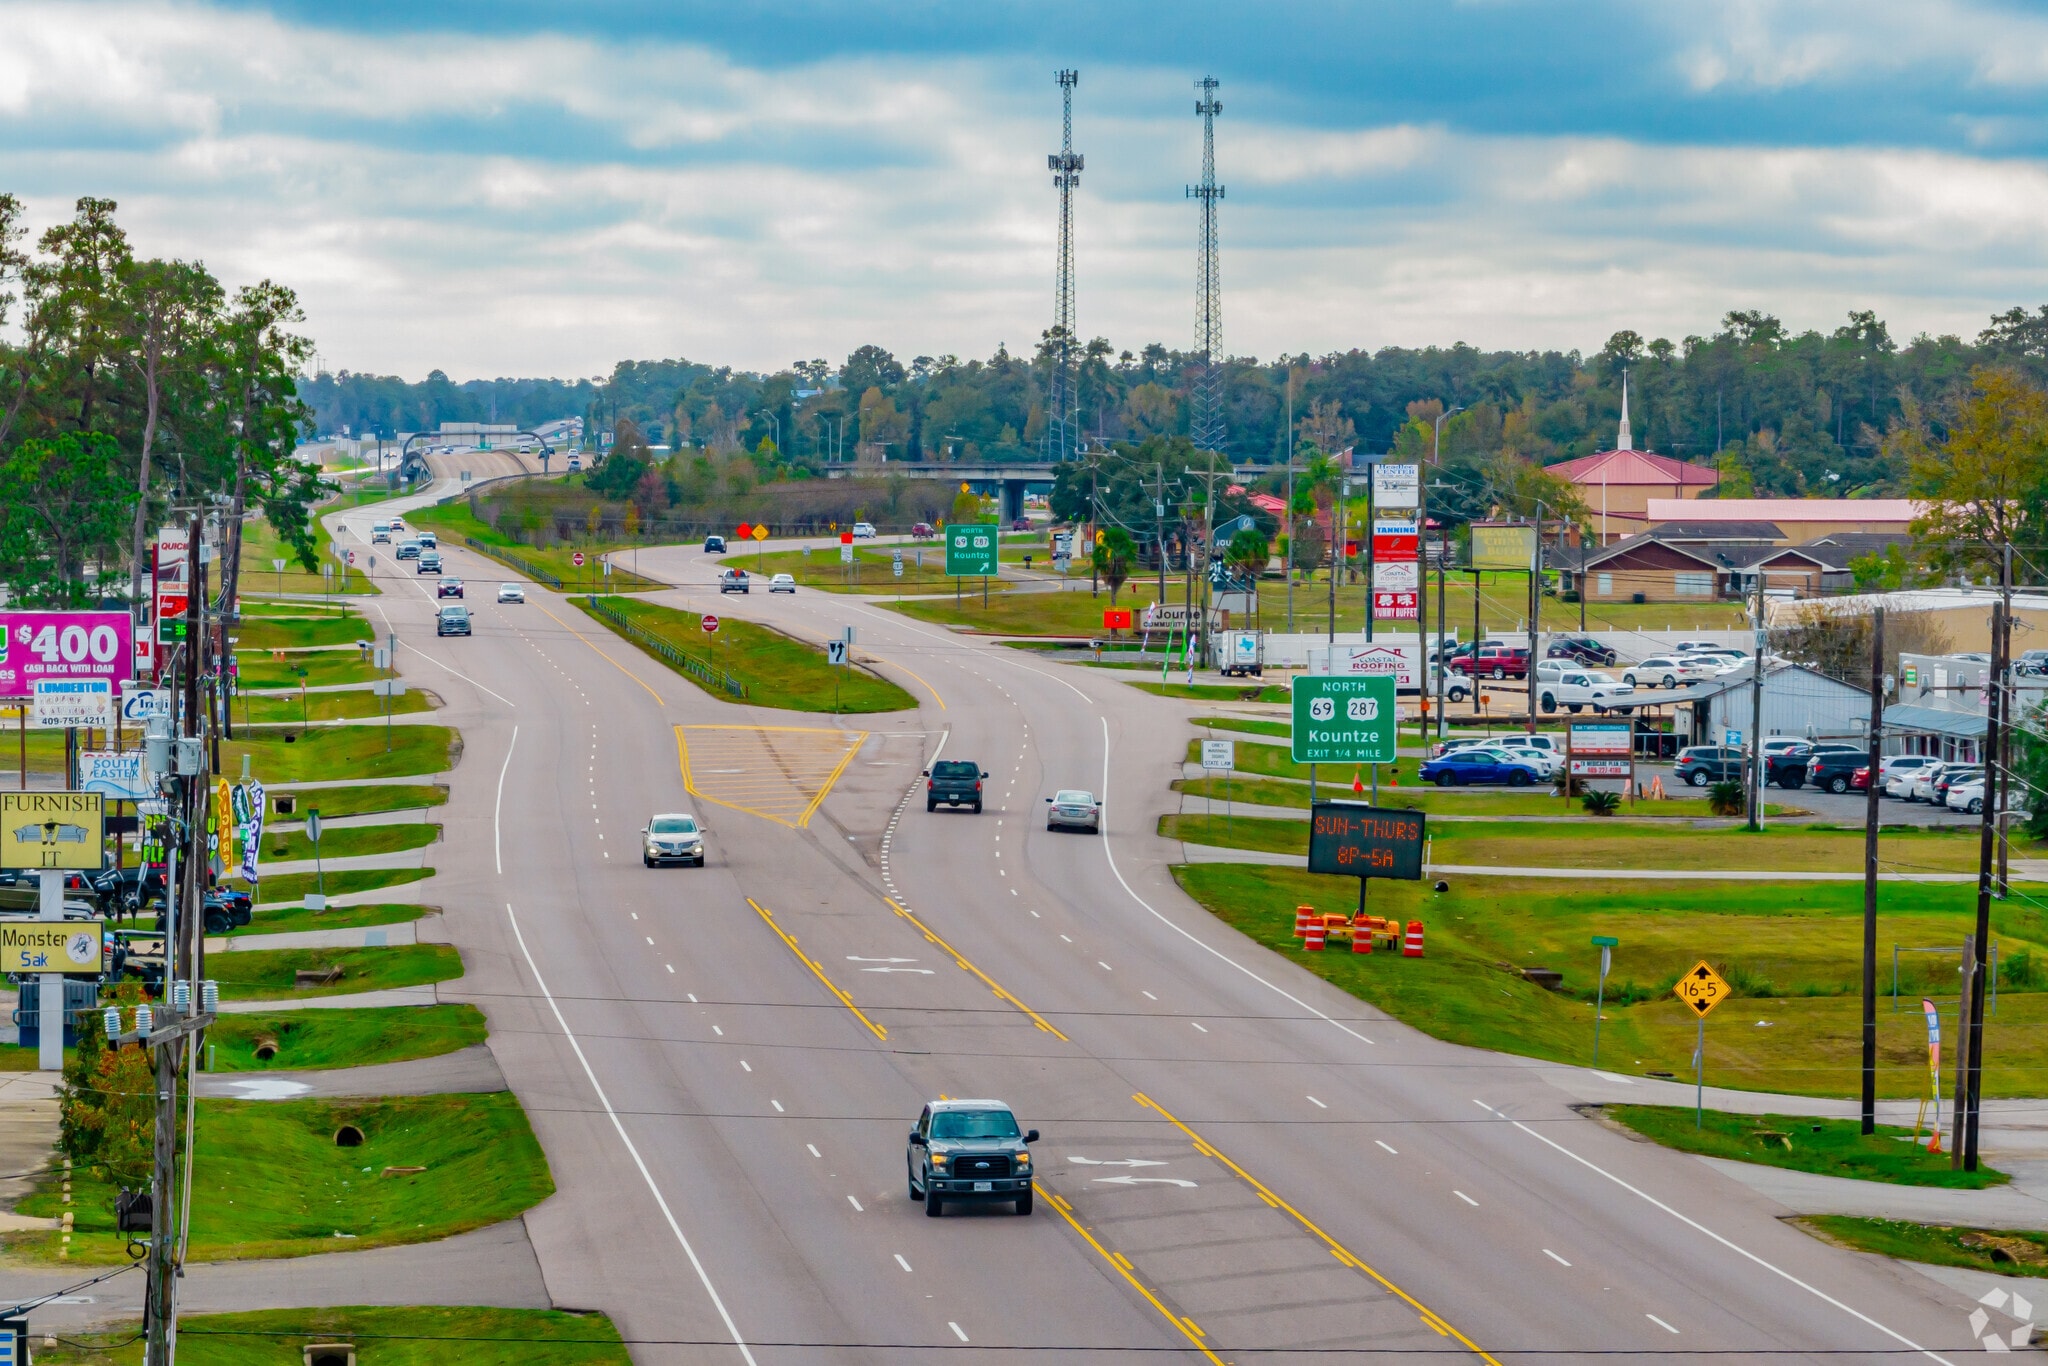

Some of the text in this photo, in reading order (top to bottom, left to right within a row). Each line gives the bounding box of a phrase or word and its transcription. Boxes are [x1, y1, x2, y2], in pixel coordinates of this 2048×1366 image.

[955, 537, 966, 546] 69
[953, 551, 990, 559] Kountze
[1374, 607, 1418, 618] YUMMY BUFFET
[18, 625, 119, 663] $400
[24, 664, 115, 673] CASH BACK WITH LOAN
[38, 682, 108, 693] LUMBERTON
[1322, 682, 1366, 692] NORTH
[1312, 702, 1376, 716] 69 287
[1309, 730, 1379, 743] Kountze
[1307, 749, 1381, 758] EXIT 1/4 MILE
[93, 759, 139, 769] SOUTH
[93, 768, 139, 778] EASTEX
[3, 795, 100, 812] FURNISH
[1314, 815, 1420, 842] SUN-THURS
[41, 850, 62, 867] IT
[1336, 846, 1394, 868] 8P-5A
[3, 928, 68, 947] Monster
[20, 951, 49, 968] Sak
